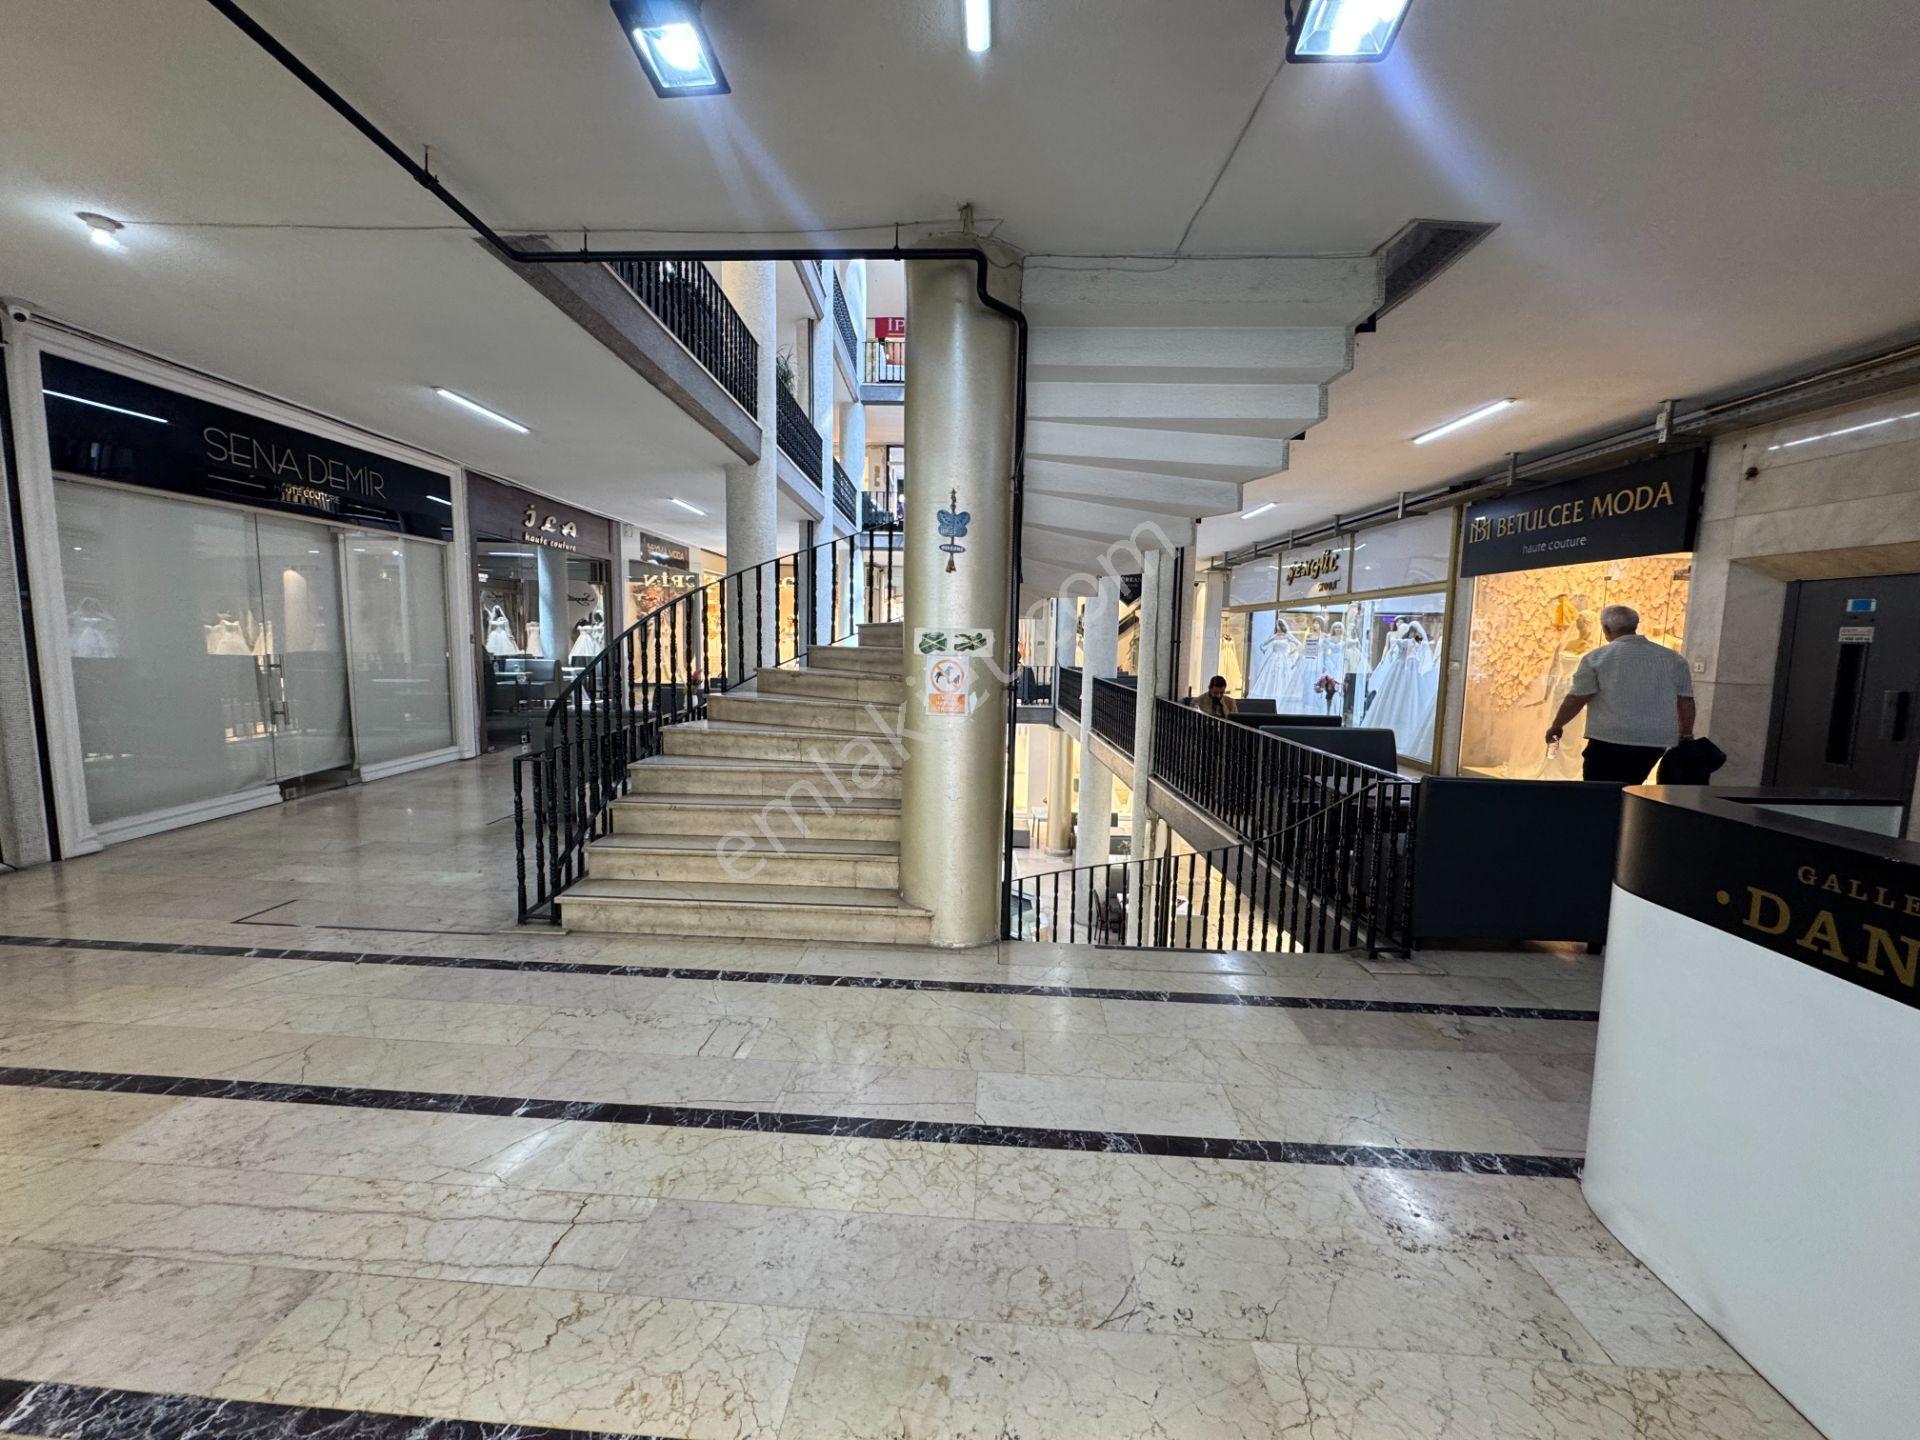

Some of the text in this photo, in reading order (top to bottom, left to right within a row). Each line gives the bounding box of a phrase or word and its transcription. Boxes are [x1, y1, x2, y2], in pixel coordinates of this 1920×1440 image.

[203, 427, 303, 479] SENA
[1496, 499, 1585, 539] BETULCEE
[1590, 481, 1675, 520] MODA
[525, 532, 577, 552] haute couture
[1521, 535, 1587, 555] haute couture
[1742, 885, 1920, 988] DAN
